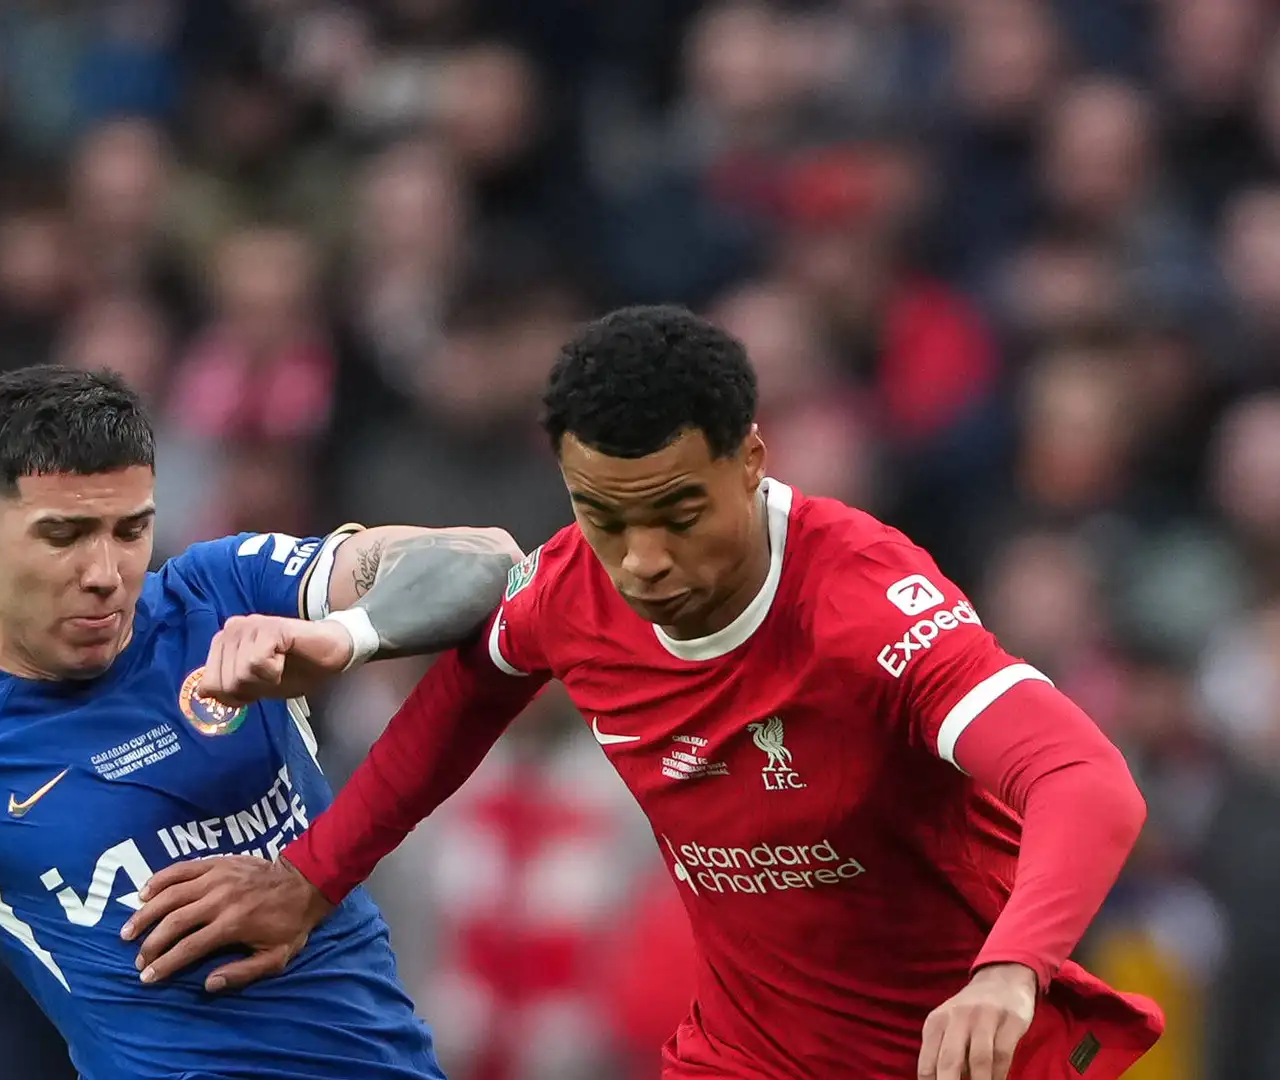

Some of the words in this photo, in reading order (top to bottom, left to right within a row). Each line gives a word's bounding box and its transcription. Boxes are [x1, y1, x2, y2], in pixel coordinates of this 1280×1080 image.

[91, 743, 130, 765] CARABAO
[129, 735, 148, 749] CUP
[146, 723, 172, 741] FINAL
[103, 760, 144, 781] WEMBLEY
[144, 742, 182, 766] STADIUM
[114, 743, 156, 768] FEBRUARY
[680, 839, 840, 869] standard
[697, 857, 866, 894] chartered
